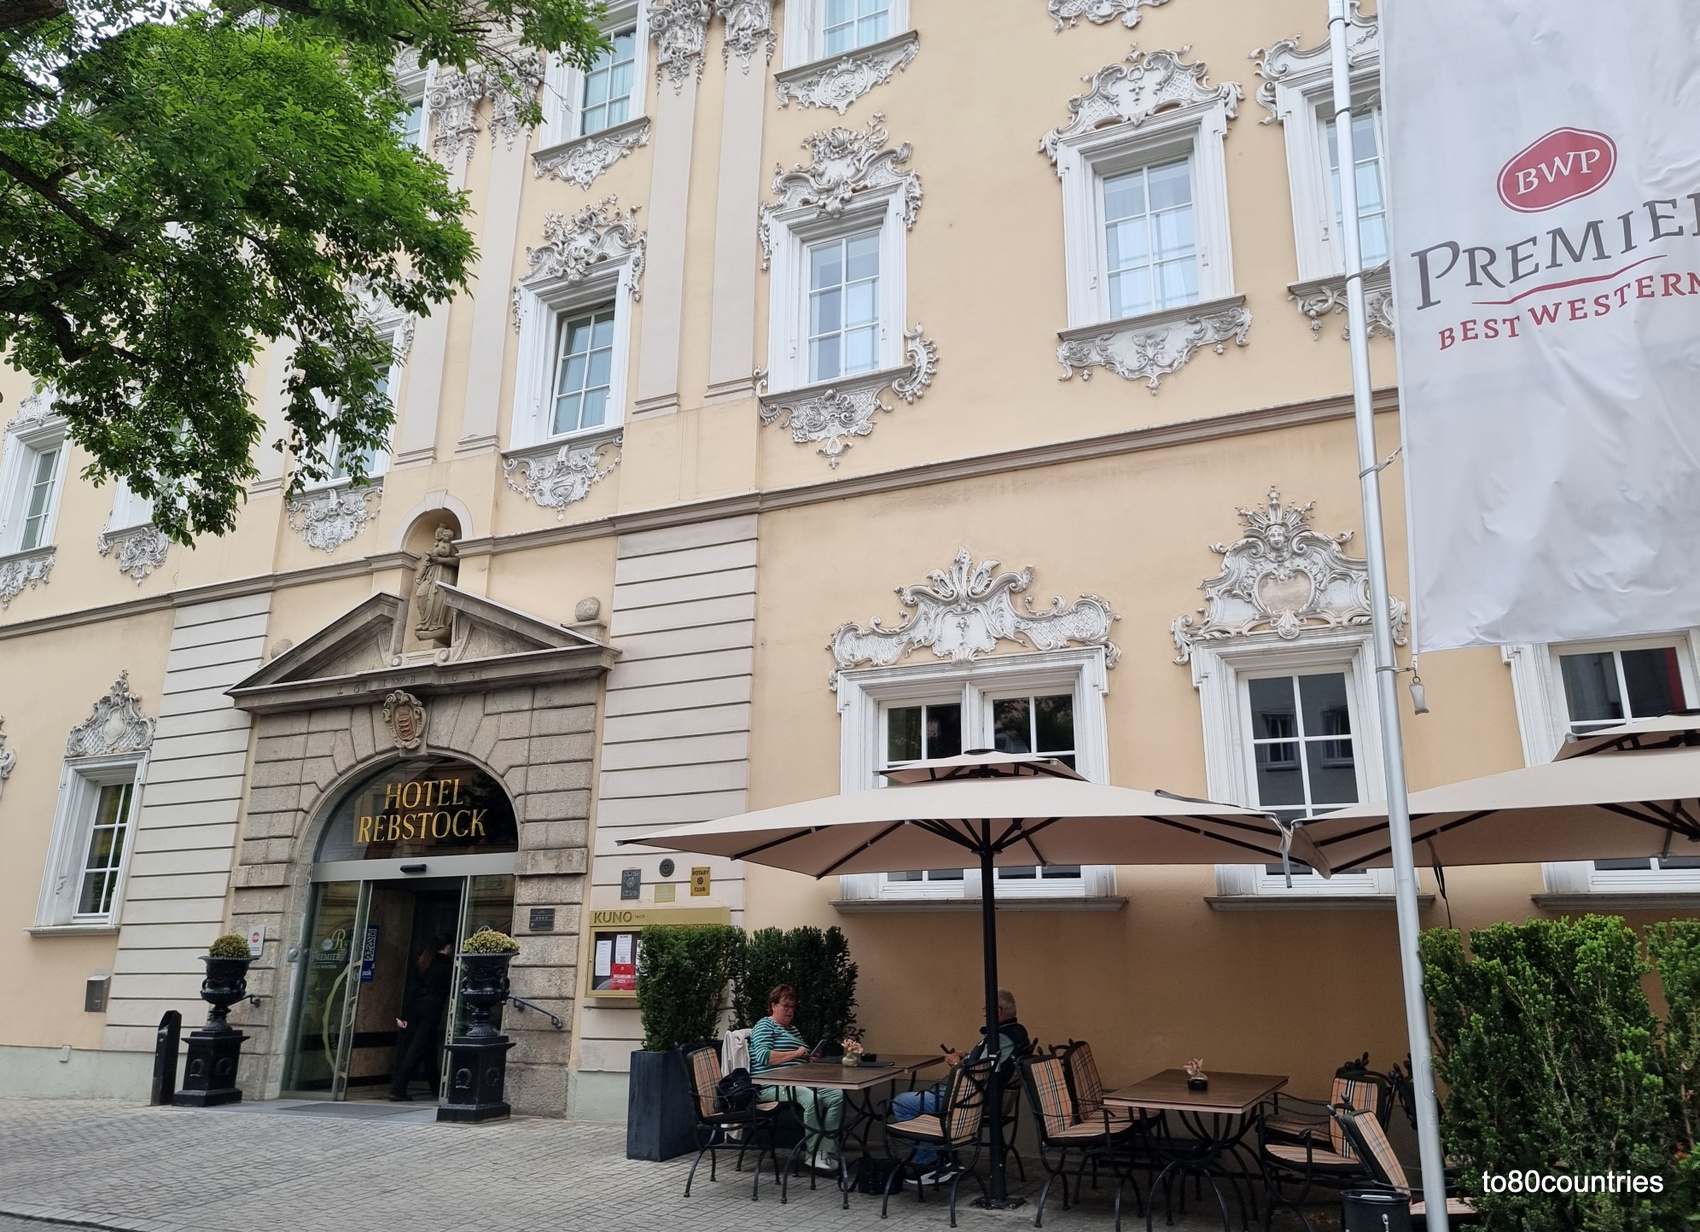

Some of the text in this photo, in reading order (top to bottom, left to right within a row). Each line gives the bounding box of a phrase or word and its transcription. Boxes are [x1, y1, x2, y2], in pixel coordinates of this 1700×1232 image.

[1514, 148, 1601, 196] BWP
[1438, 315, 1520, 350] BEST
[384, 778, 464, 809] HOTEL
[357, 808, 489, 843] REBSTOCK
[593, 911, 633, 923] KUNO
